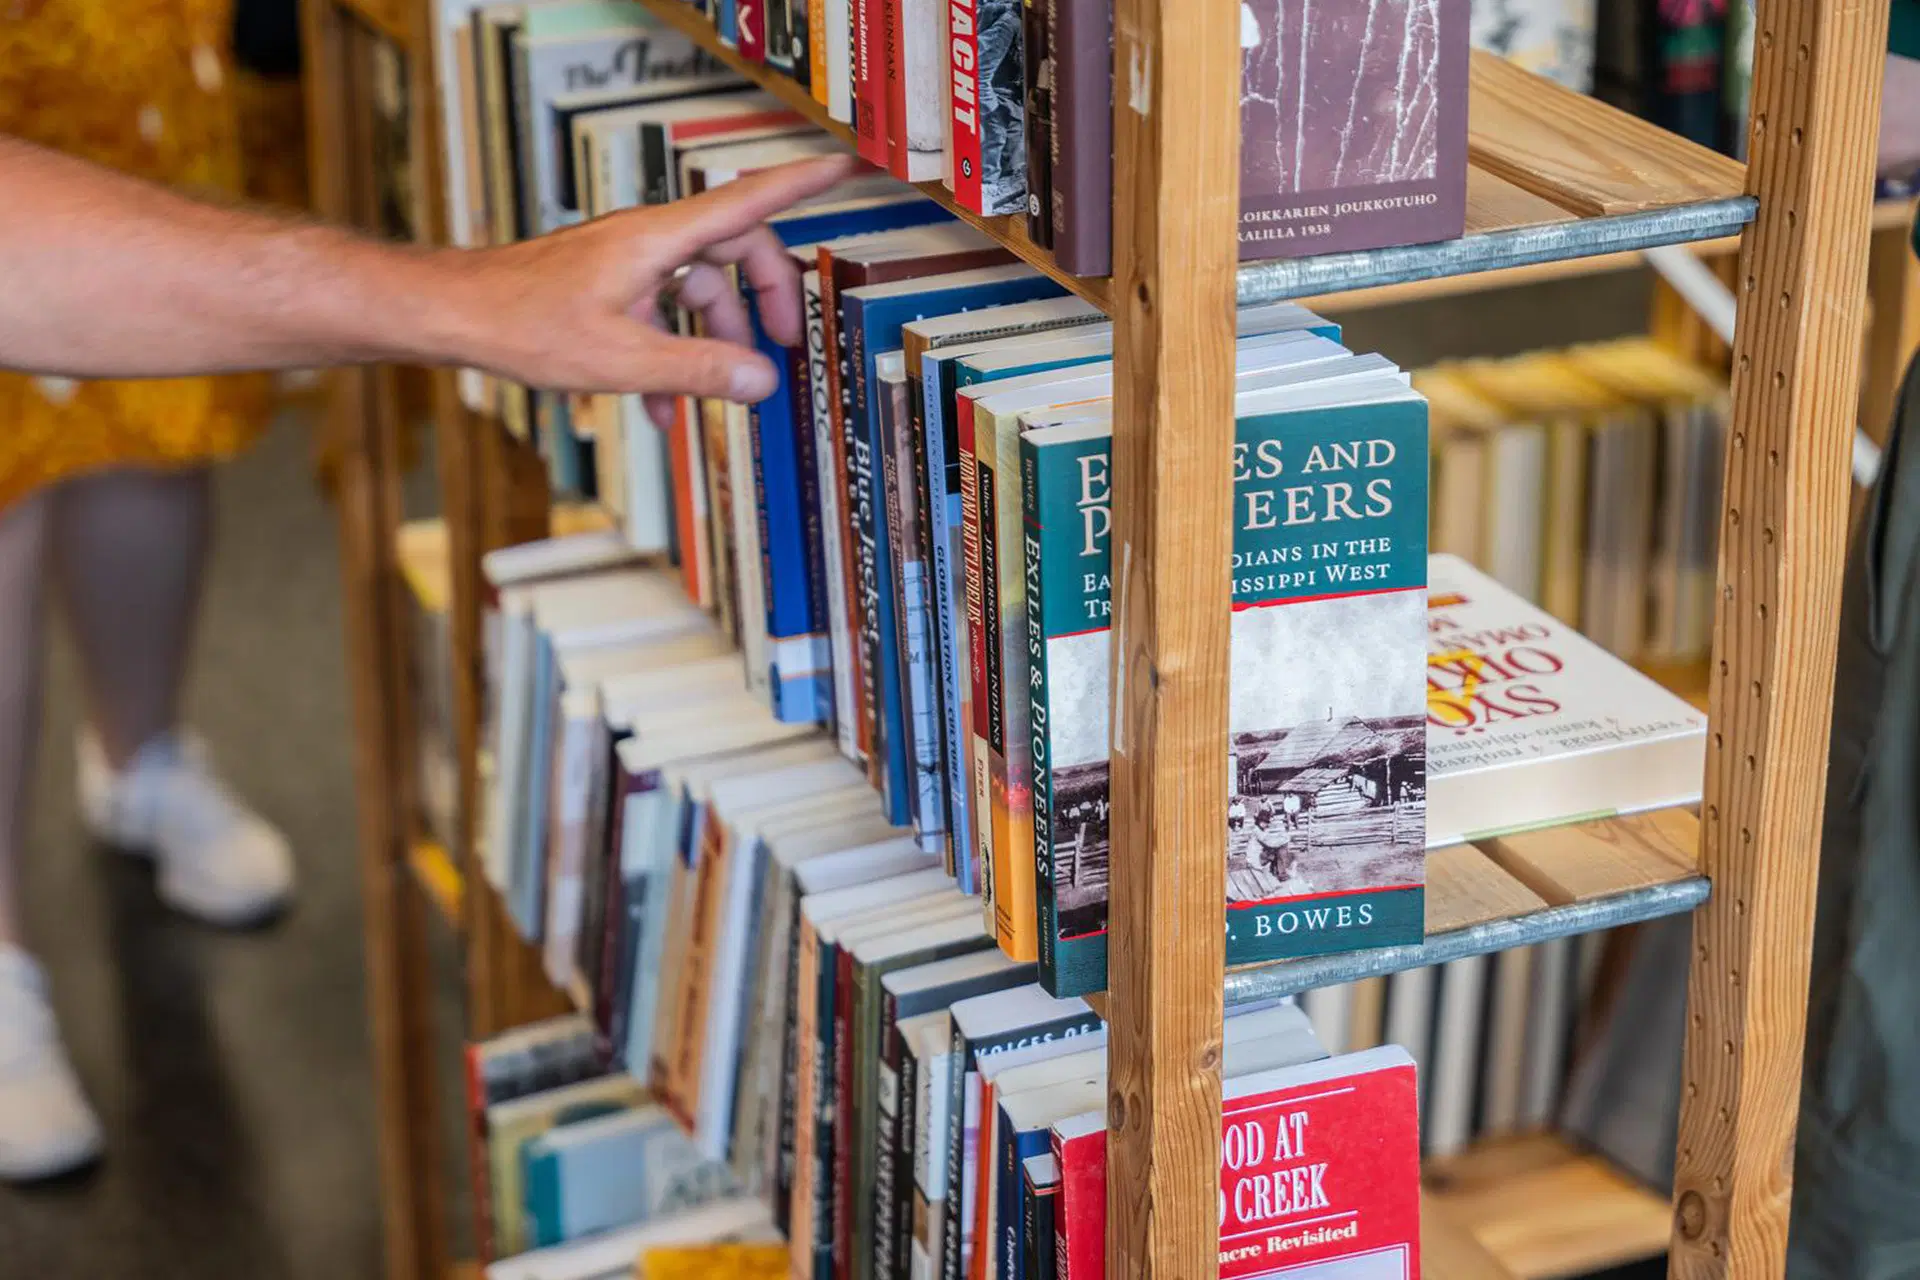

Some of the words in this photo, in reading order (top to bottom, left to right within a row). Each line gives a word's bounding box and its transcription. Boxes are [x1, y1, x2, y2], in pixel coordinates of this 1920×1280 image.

[859, 0, 868, 81] ELKÄNAHASTA
[1301, 223, 1331, 236] 1938
[1333, 193, 1438, 217] JOUKKOTUHO
[855, 436, 873, 526] Blue
[957, 448, 978, 518] MONTANA
[1301, 438, 1396, 475] AND
[962, 518, 982, 626] BATTLEFIELDS
[1231, 546, 1302, 570] DIANS
[1311, 541, 1339, 560] IN
[1344, 537, 1392, 555] THE
[1324, 562, 1391, 583] WEST
[859, 526, 880, 645] Jacket
[936, 545, 953, 685] GLOBALIZATION
[1025, 535, 1042, 658] EXILES
[983, 536, 997, 636] JEFFERSON
[990, 668, 1002, 746] INDIANS
[1029, 664, 1043, 691] &
[1030, 699, 1049, 878] PIONEERS
[1254, 903, 1374, 938] BOWES
[1272, 1110, 1309, 1161] AT
[1234, 1162, 1331, 1224] CREEK
[1219, 1243, 1262, 1264] acre
[1266, 1220, 1359, 1254] Revisited
